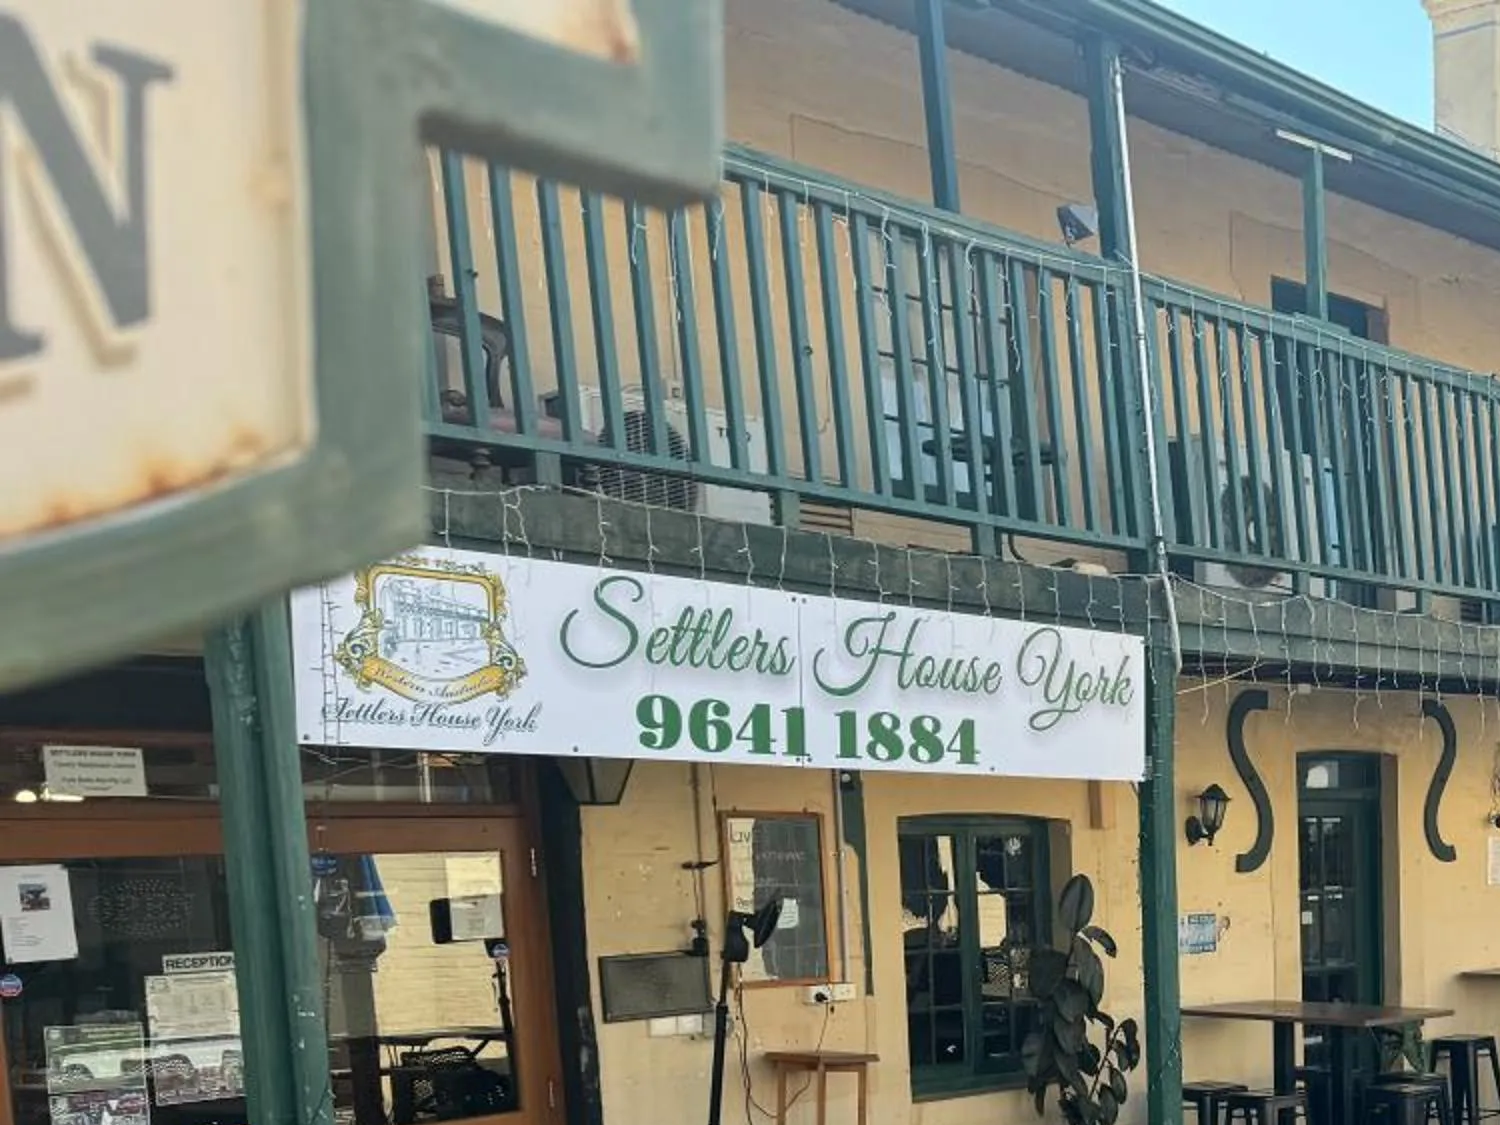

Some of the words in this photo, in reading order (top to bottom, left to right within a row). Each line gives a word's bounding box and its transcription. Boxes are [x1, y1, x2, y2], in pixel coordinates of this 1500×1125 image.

[560, 575, 796, 676] Settlers
[813, 611, 1002, 697] House
[1016, 627, 1135, 731] York
[410, 702, 482, 729] House
[483, 702, 543, 746] York
[636, 694, 811, 757] 9641
[834, 707, 981, 765] 1884
